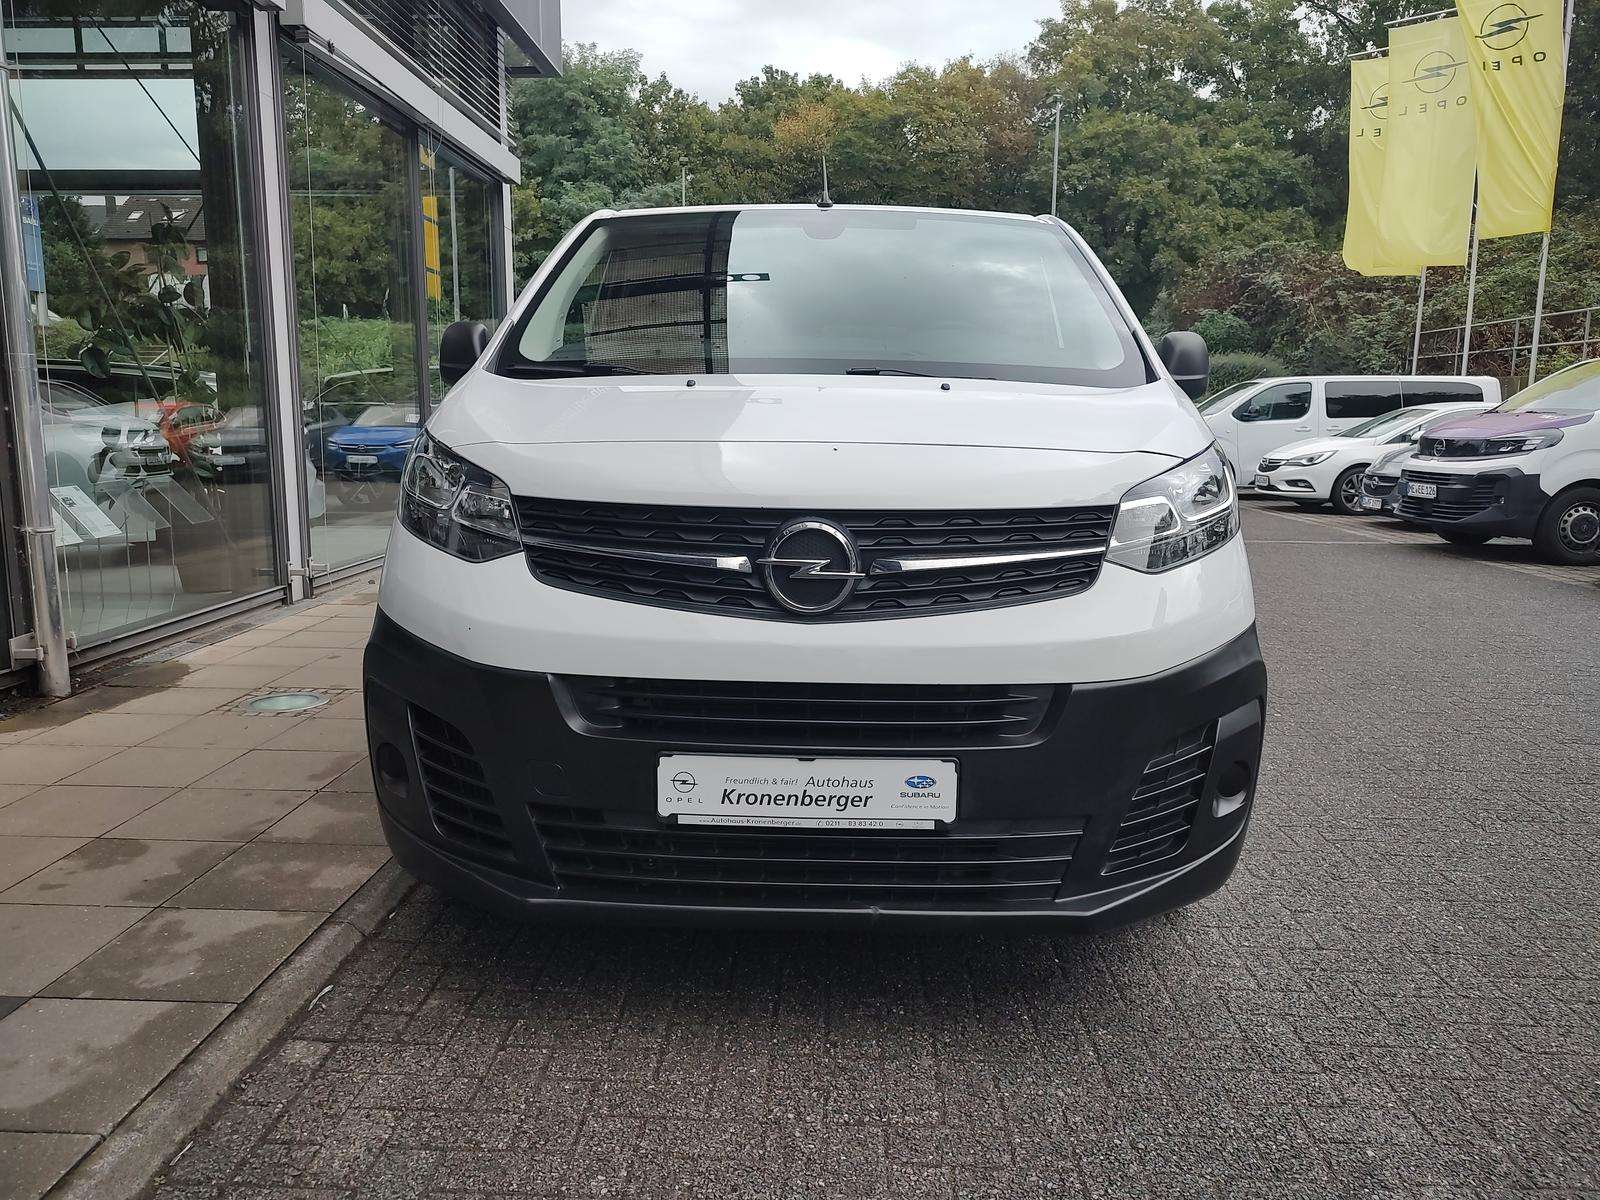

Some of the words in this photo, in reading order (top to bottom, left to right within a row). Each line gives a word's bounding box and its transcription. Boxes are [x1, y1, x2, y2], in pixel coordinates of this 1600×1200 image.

[724, 776, 769, 785] Freundlich
[771, 777, 778, 785] &
[780, 777, 799, 786] fair!
[804, 776, 875, 788] Autohaus
[665, 796, 704, 804] OPEL
[720, 788, 874, 812] Kronenberger
[900, 791, 941, 799] SUBARU
